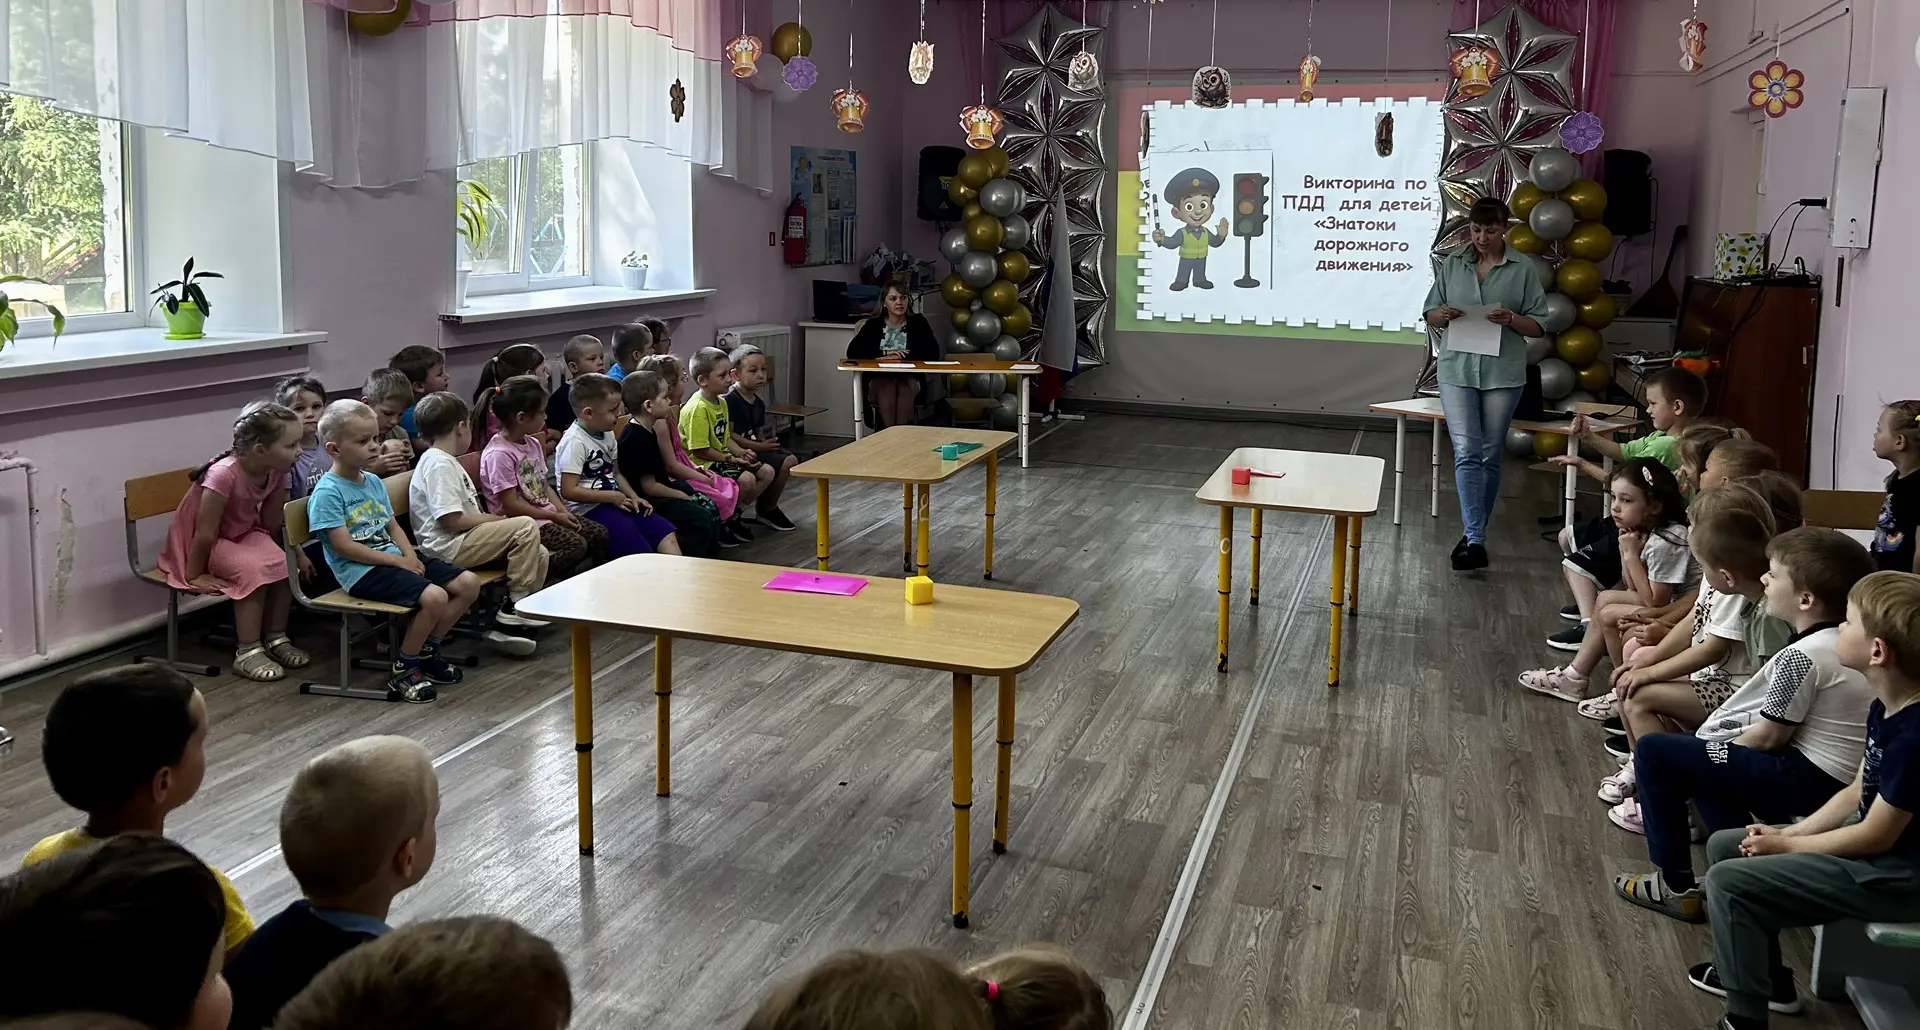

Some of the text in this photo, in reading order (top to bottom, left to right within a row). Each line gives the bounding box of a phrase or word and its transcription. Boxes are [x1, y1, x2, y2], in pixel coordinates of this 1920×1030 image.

[1303, 174, 1427, 193] Викторина по
[1282, 195, 1432, 212] ПДД для детей
[1313, 215, 1396, 231] «Знатоки
[1313, 239, 1410, 254] дорожного
[1315, 259, 1414, 273] движения»
